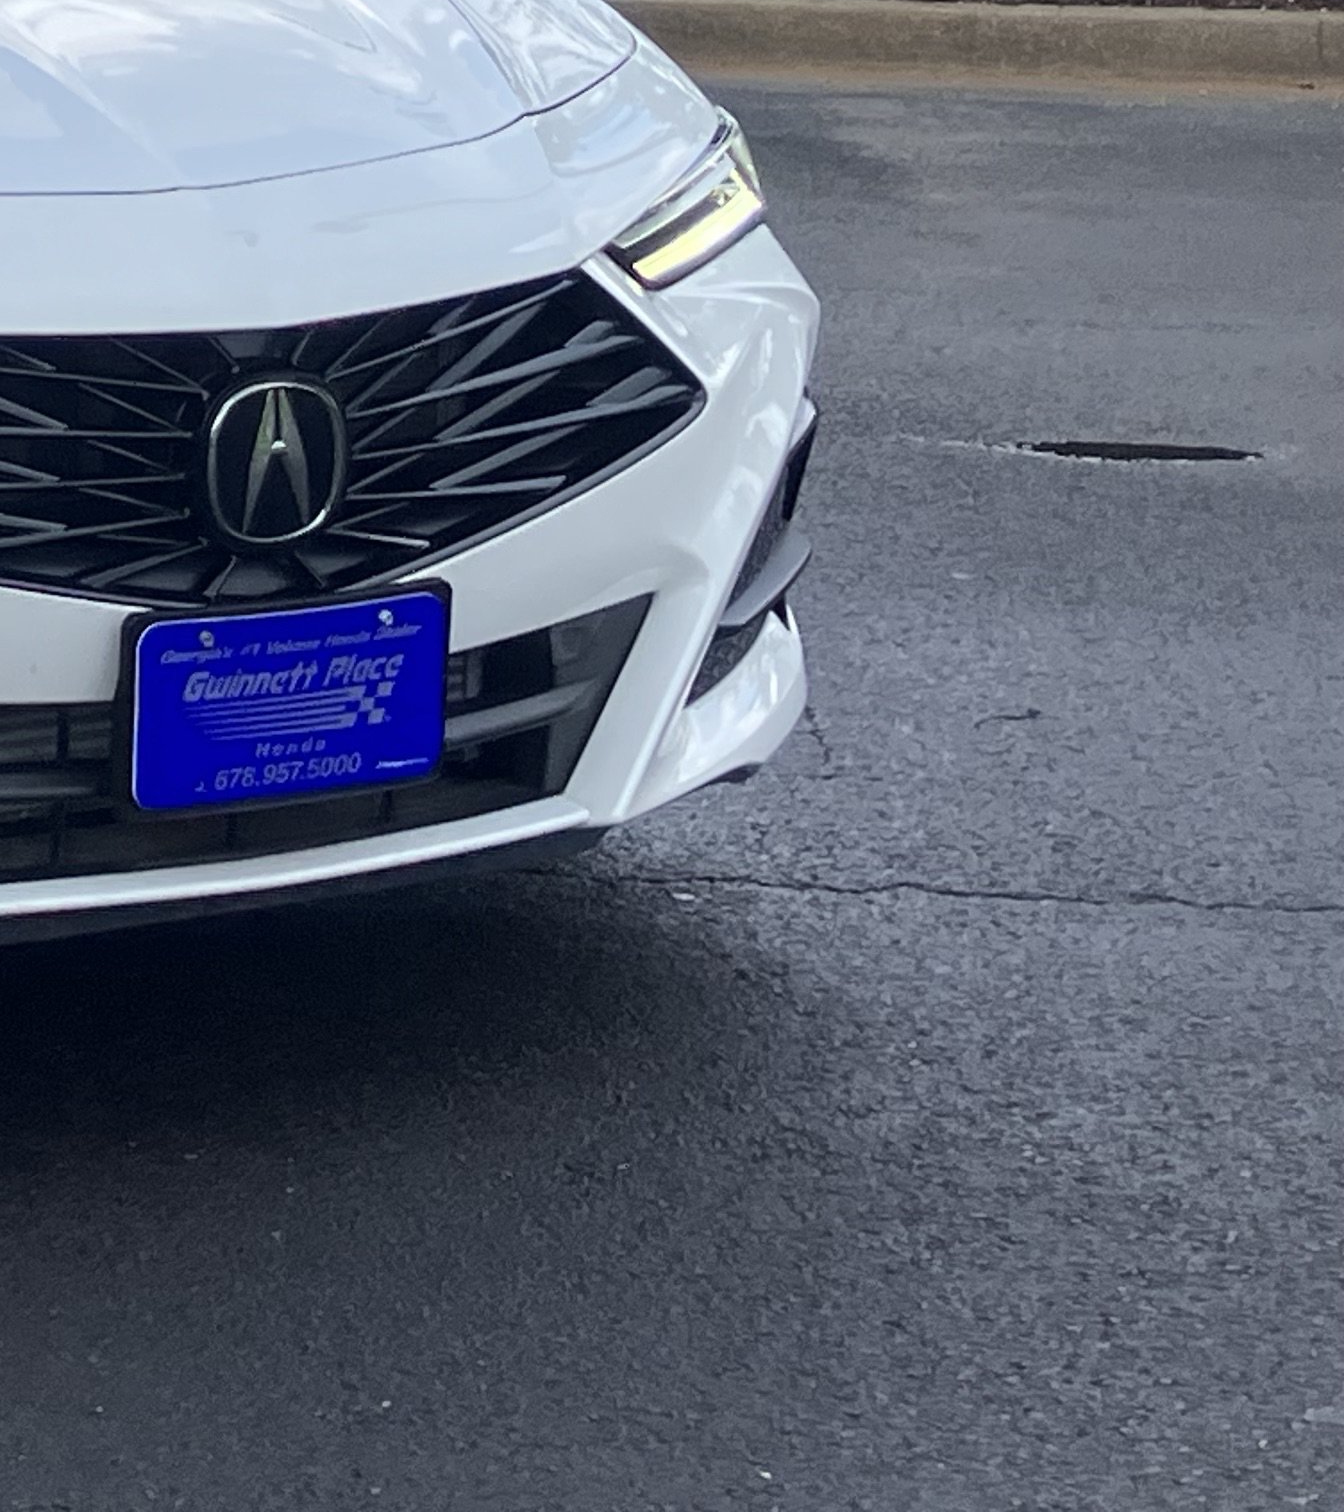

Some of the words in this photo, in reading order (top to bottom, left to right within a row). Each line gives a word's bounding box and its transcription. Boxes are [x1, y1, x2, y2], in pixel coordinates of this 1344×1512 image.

[181, 659, 319, 703] Gwinnett
[322, 653, 405, 687] Place
[255, 736, 326, 759] Honda
[213, 751, 362, 793] 678.957.5000
